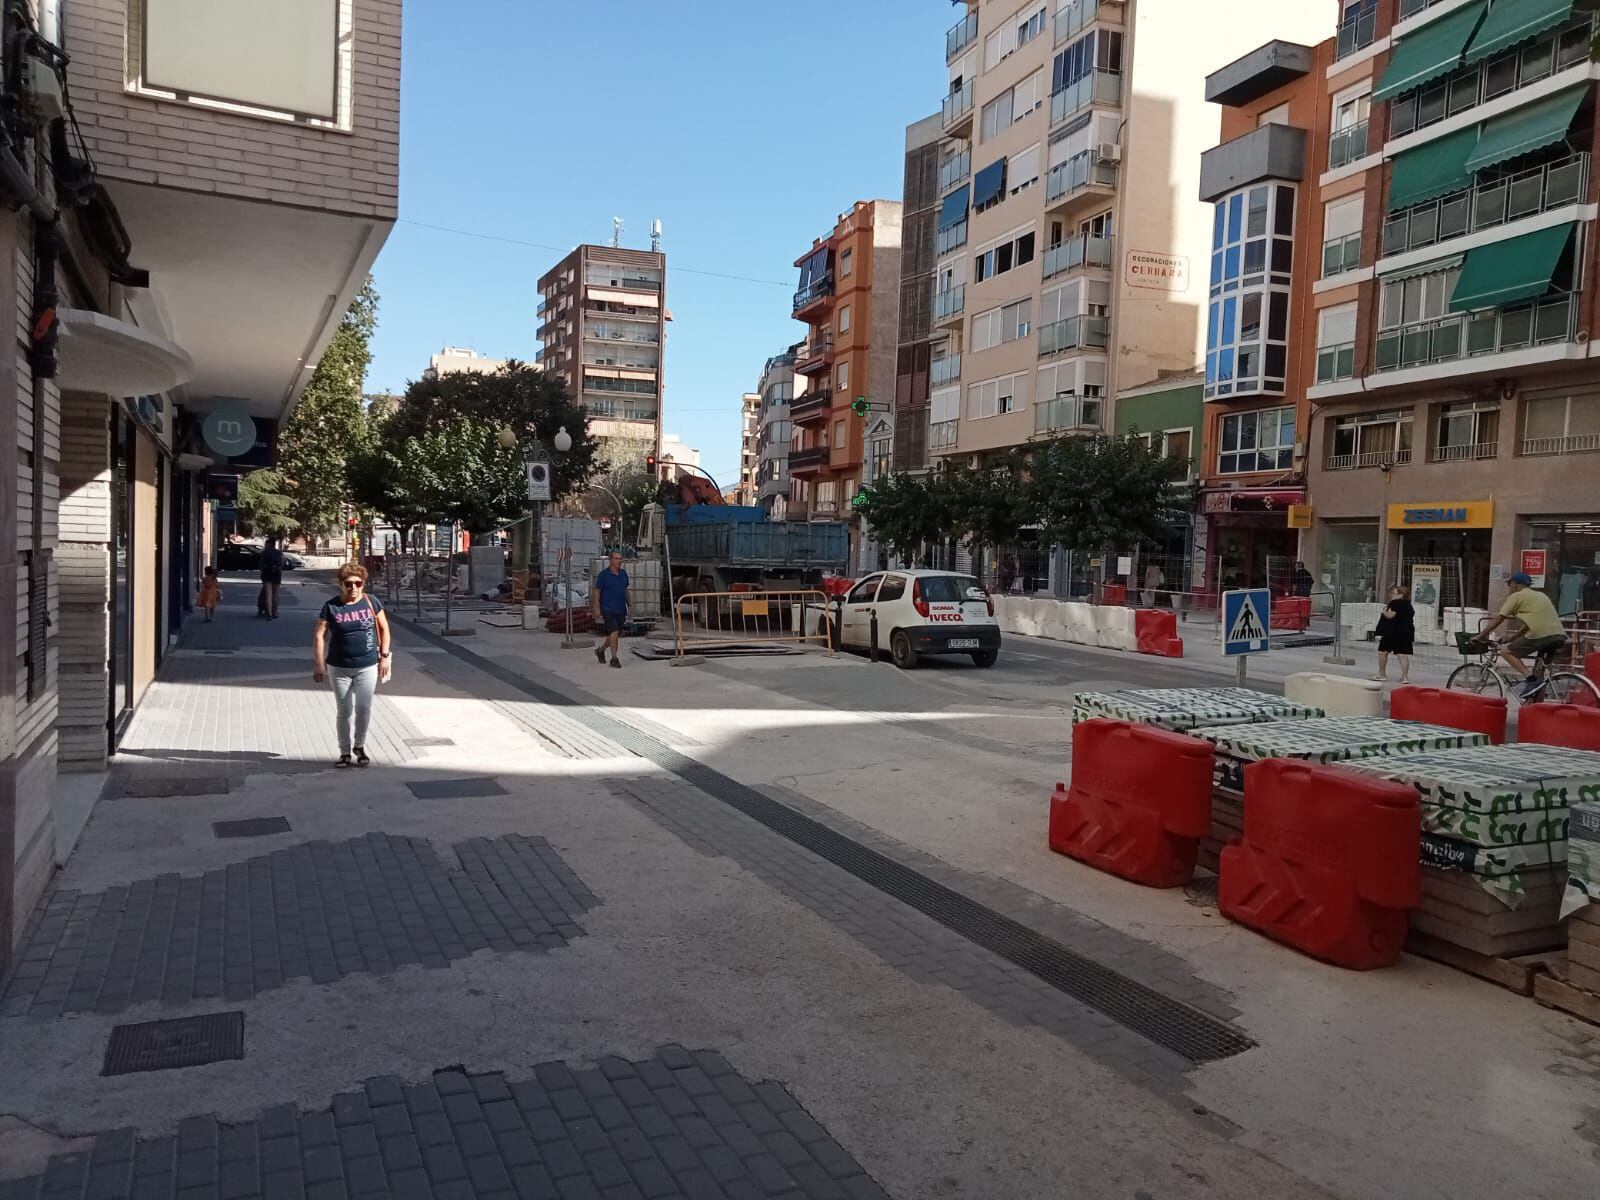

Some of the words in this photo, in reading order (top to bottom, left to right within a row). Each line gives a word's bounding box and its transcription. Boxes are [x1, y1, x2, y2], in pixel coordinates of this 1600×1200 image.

[1132, 255, 1182, 266] DECORACIONES
[1403, 508, 1468, 524] ZEEMAN
[335, 608, 373, 624] SANTA
